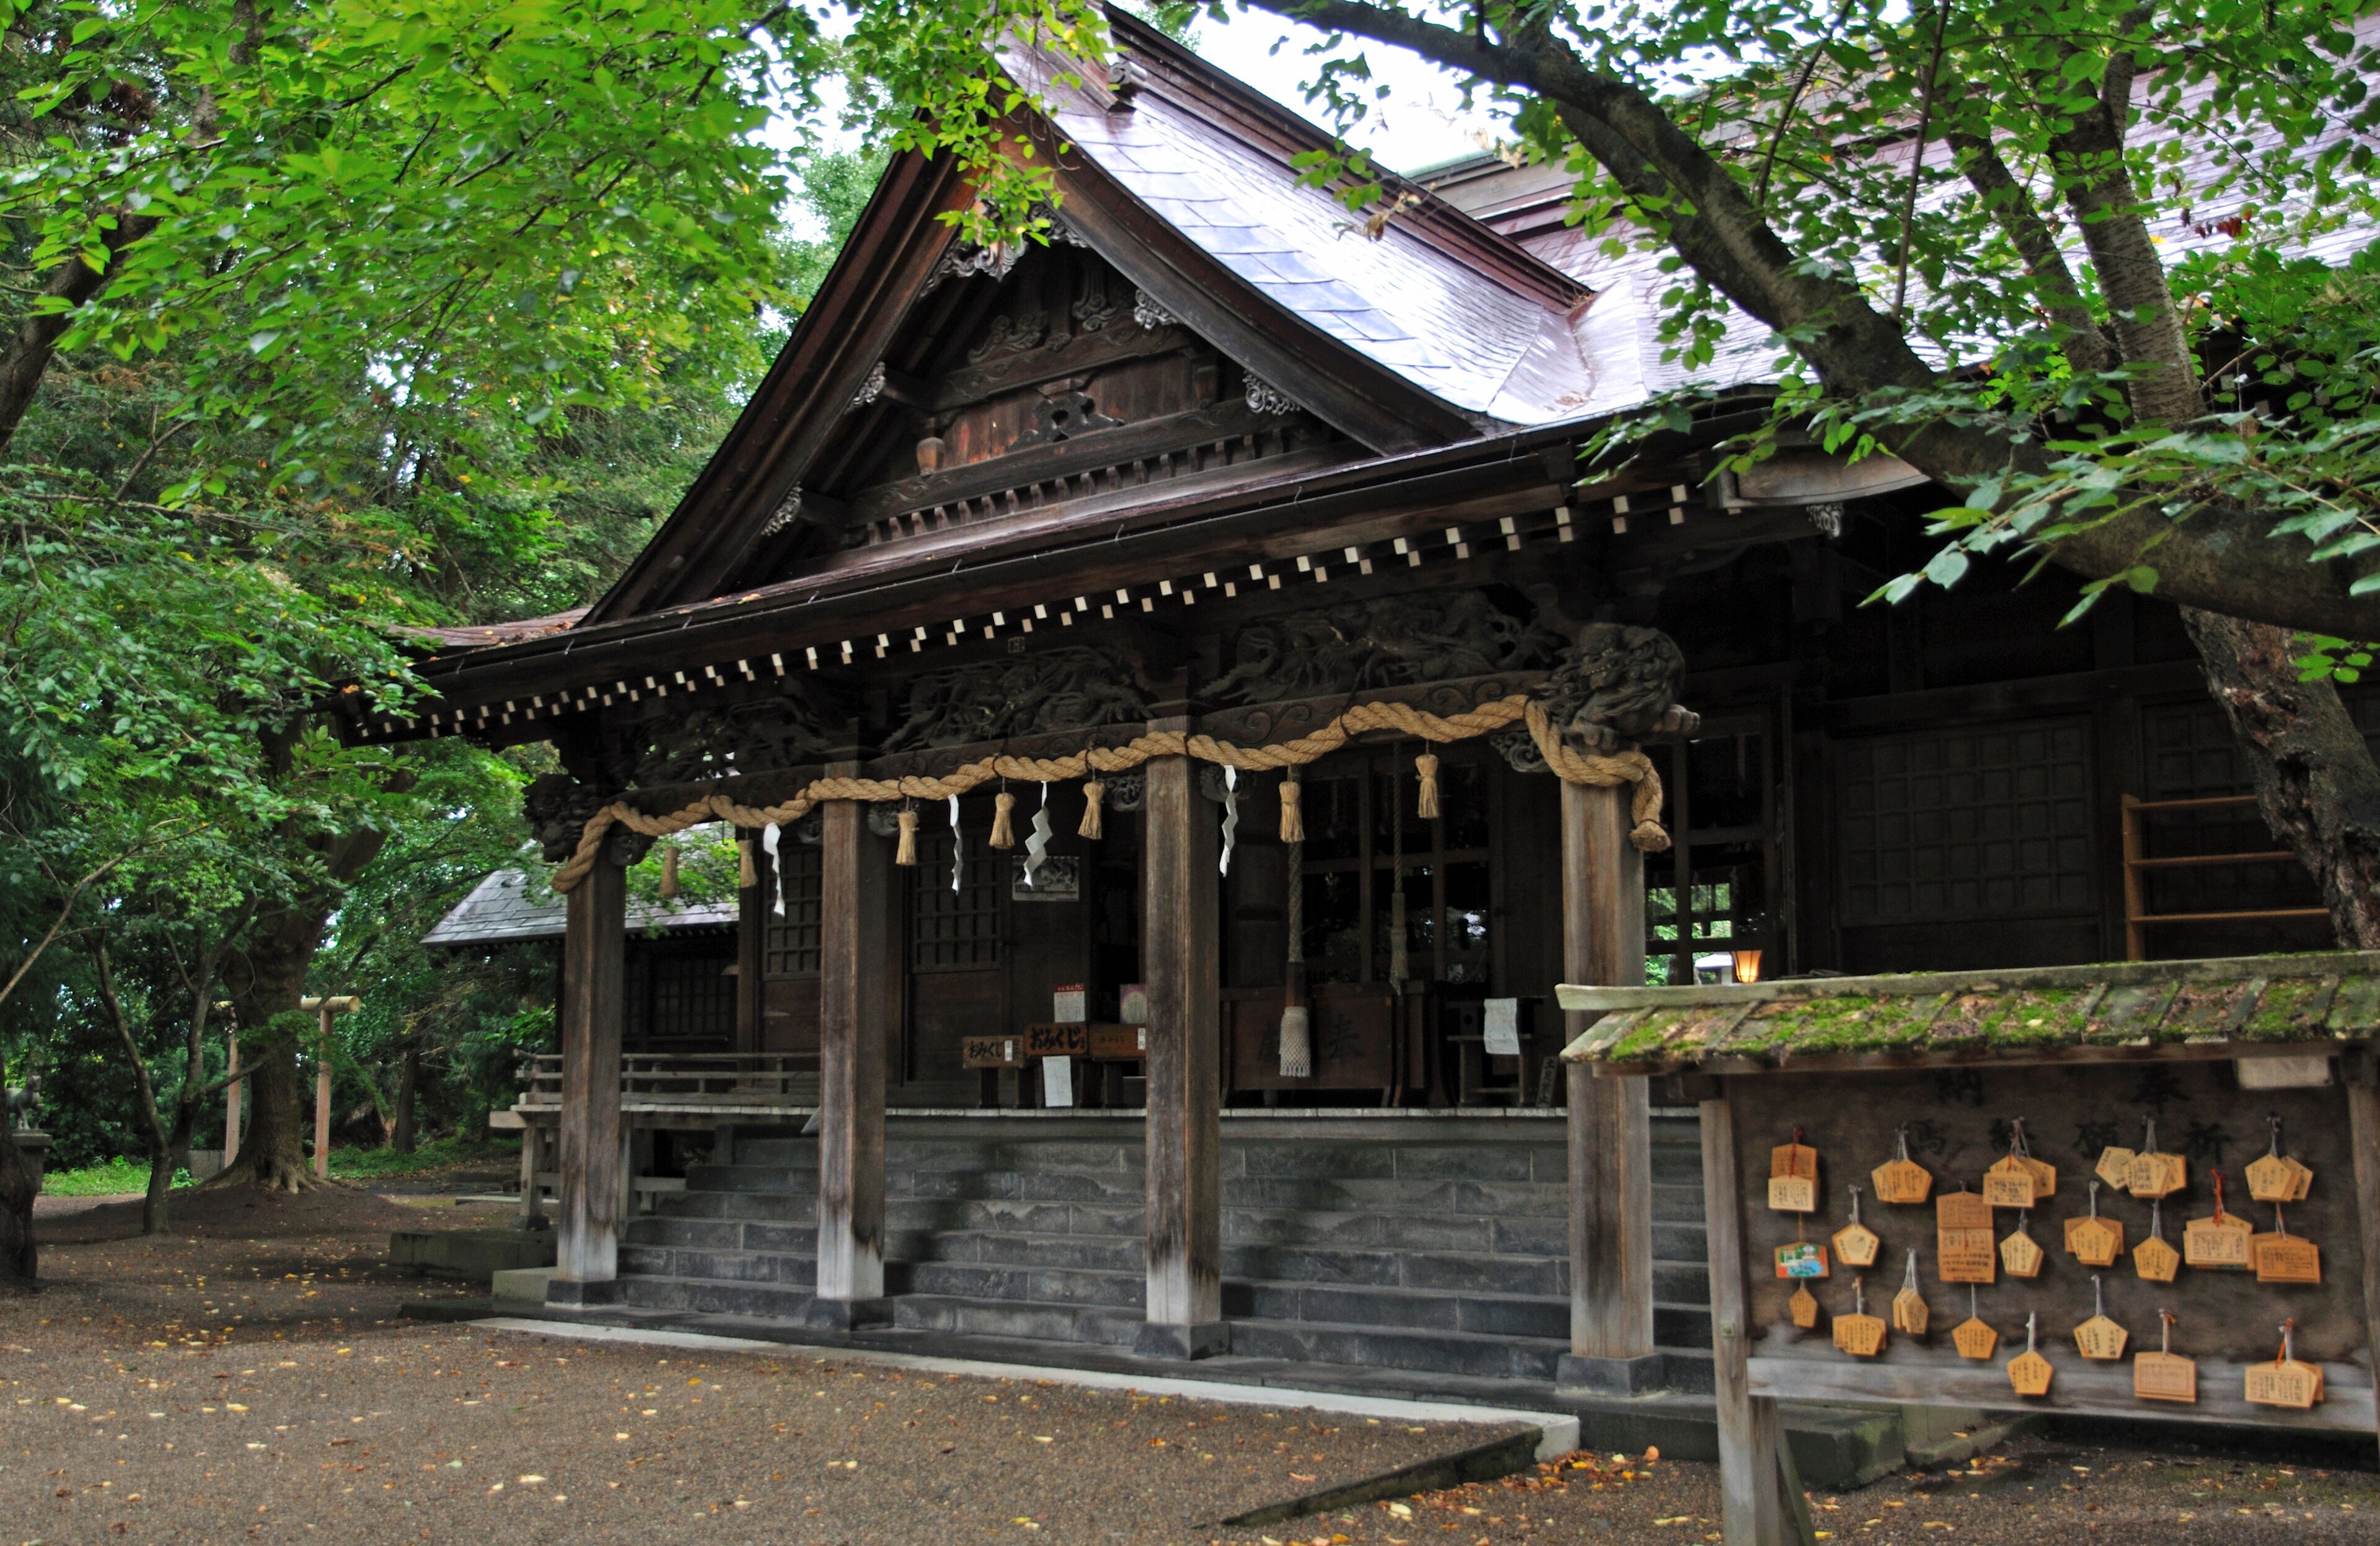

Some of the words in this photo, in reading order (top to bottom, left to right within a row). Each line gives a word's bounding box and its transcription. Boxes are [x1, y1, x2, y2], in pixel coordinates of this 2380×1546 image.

[968, 1040, 1002, 1058] おみくじ
[1030, 1027, 1081, 1051] おみくじ
